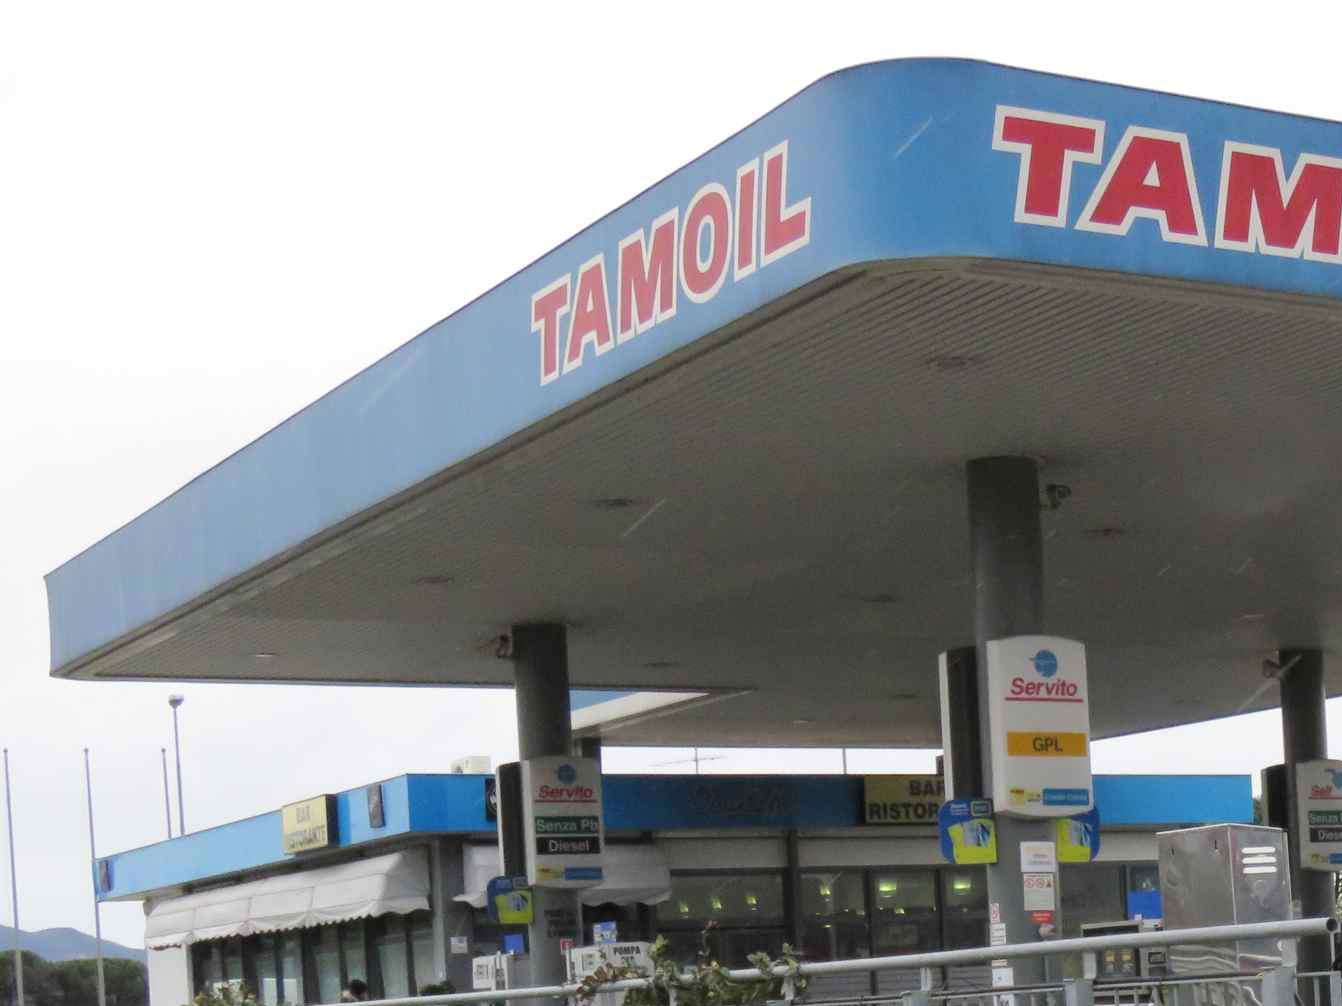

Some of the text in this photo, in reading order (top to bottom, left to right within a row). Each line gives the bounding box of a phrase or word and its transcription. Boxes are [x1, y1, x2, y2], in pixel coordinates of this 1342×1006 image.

[531, 139, 811, 386] TAMOIL
[1010, 677, 1078, 697] Servito
[1032, 736, 1063, 752] GPL
[538, 785, 593, 800] Servito
[536, 818, 598, 832] Senza Pb
[549, 839, 591, 851] Diesel
